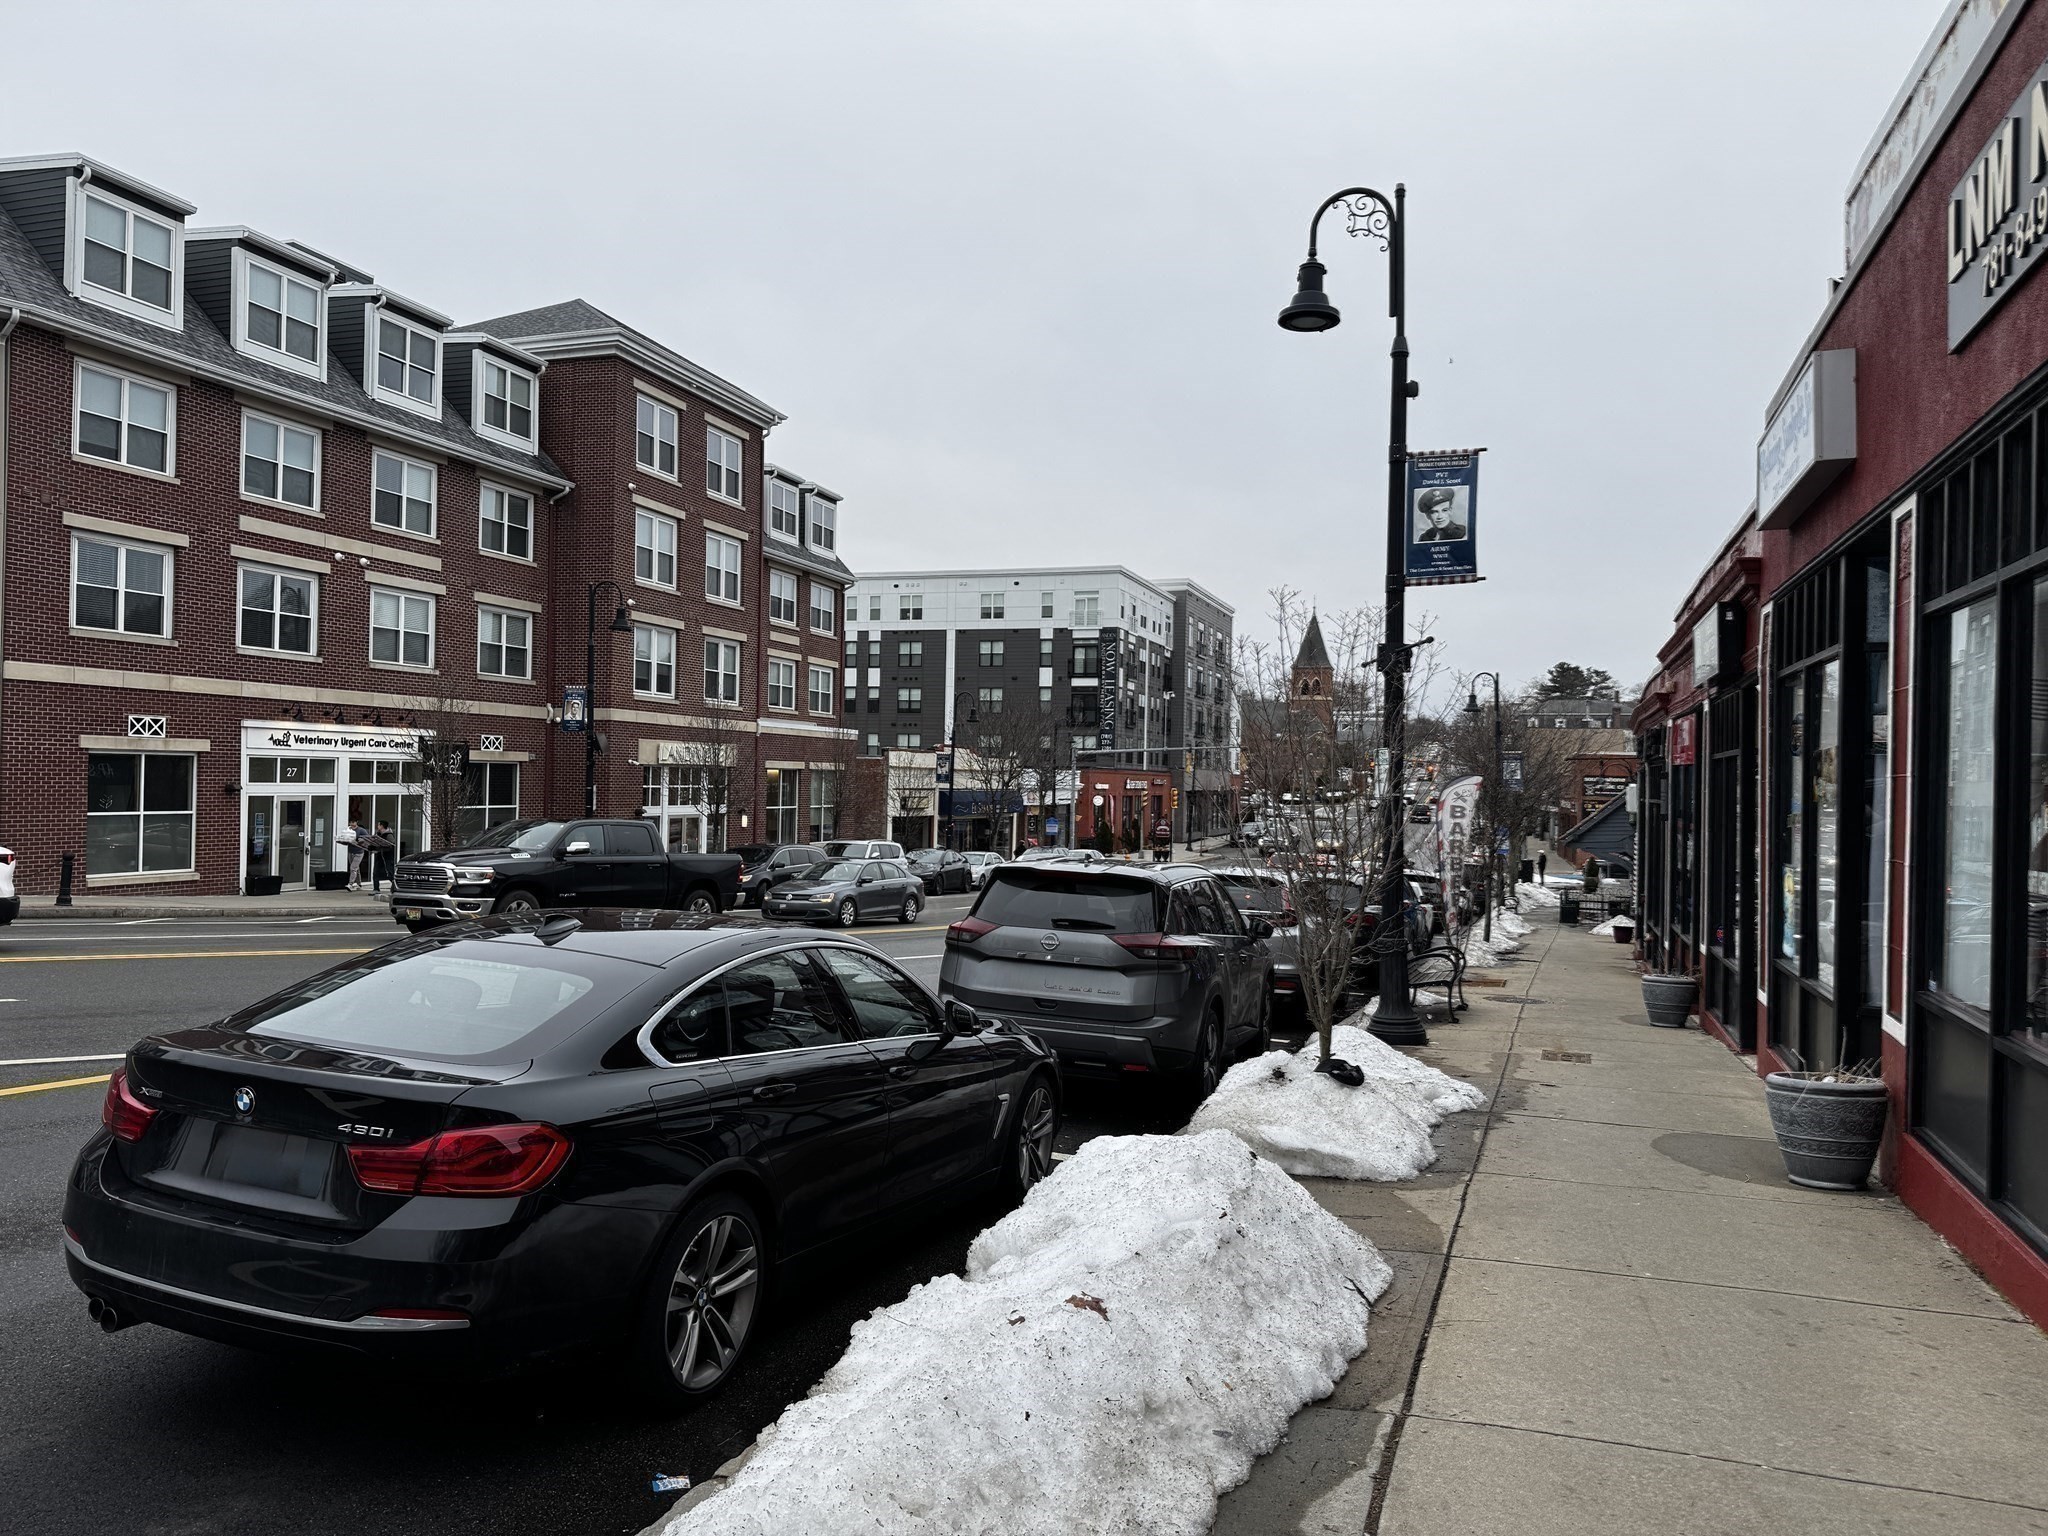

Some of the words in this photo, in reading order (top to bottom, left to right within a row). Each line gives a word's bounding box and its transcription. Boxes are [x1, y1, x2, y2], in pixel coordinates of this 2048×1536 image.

[1948, 117, 2015, 283] LNM
[1106, 642, 1116, 674] NOW
[1104, 680, 1115, 730] LEASING
[293, 734, 339, 748] Veterinary
[341, 737, 366, 748] Urgent
[368, 738, 387, 748] Care
[388, 740, 414, 749] Center
[286, 767, 298, 777] 27
